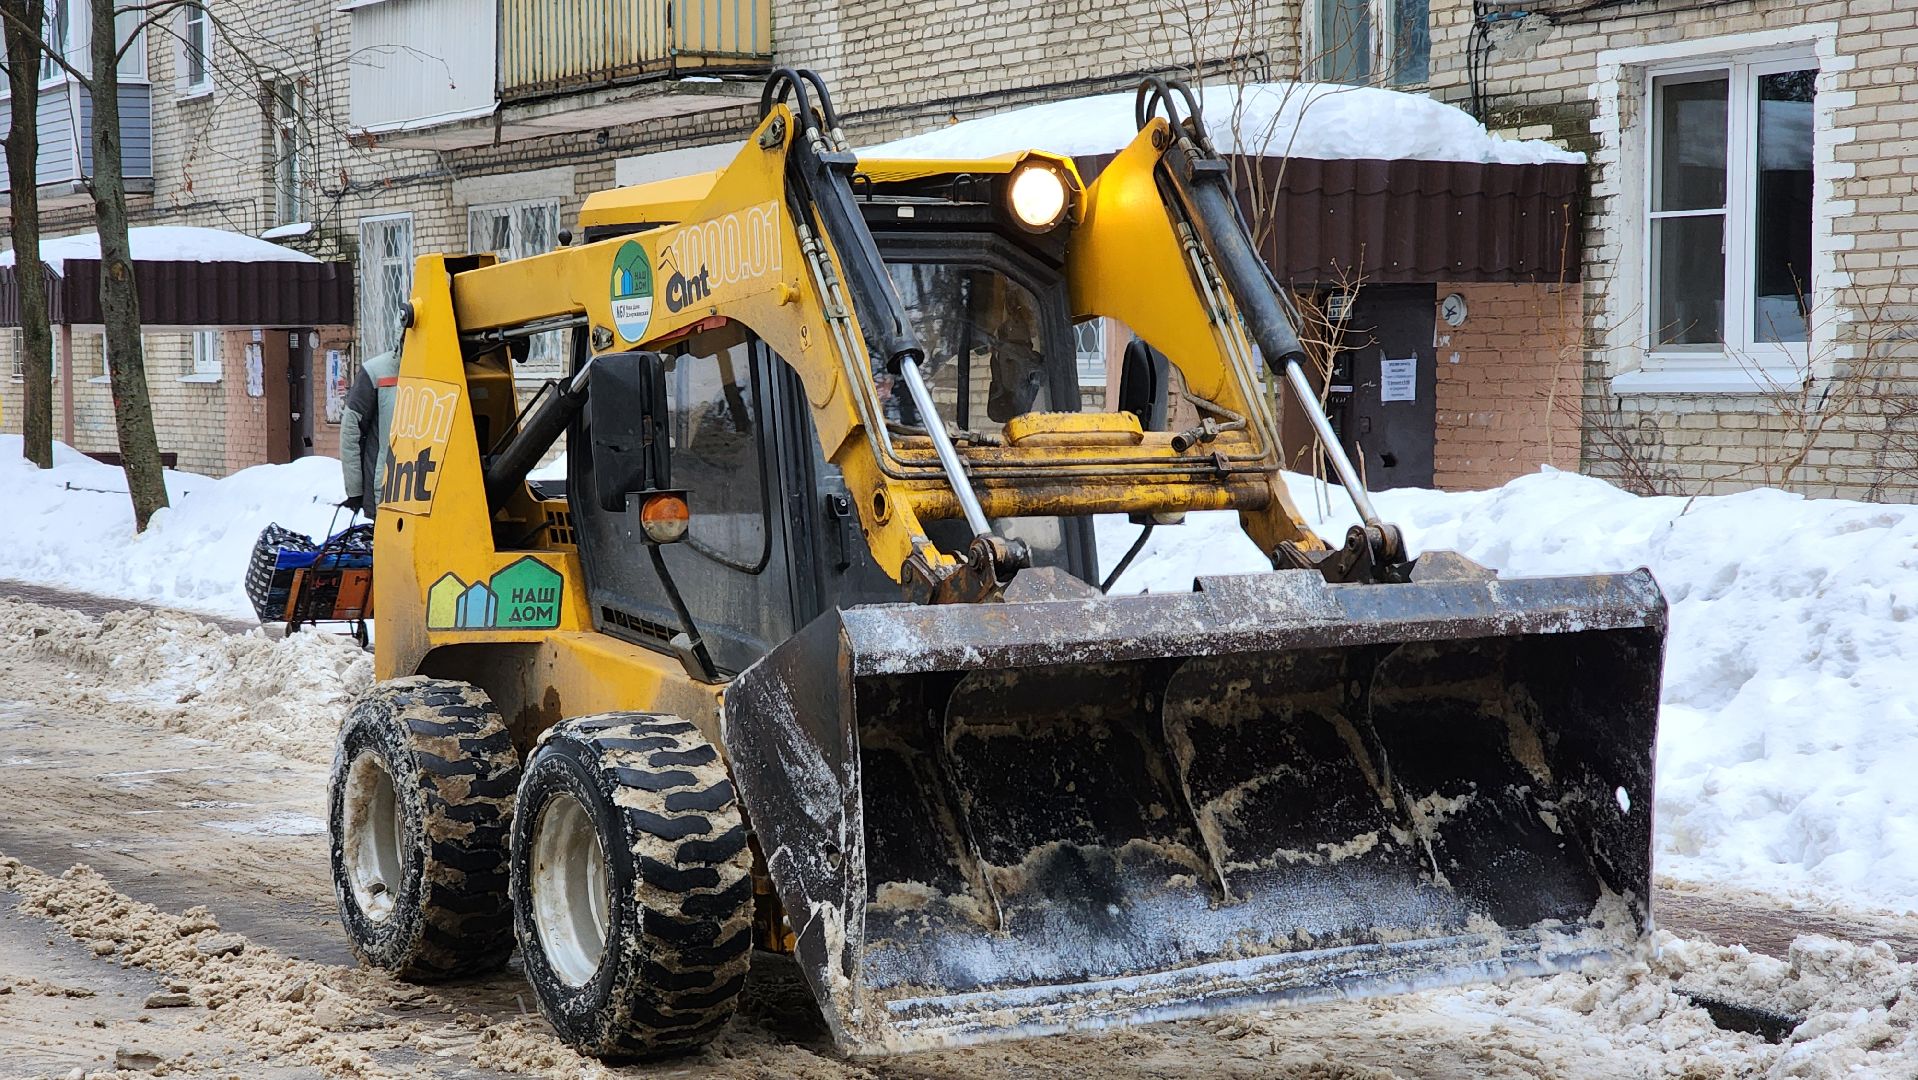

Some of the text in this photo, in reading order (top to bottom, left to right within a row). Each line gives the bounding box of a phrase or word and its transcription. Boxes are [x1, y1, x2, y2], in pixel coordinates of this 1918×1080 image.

[671, 201, 783, 289] 1000.01
[634, 270, 647, 280] НАШ
[633, 280, 647, 291] ДОМ
[511, 587, 556, 604] НАШ
[508, 605, 553, 623] ДОМ
